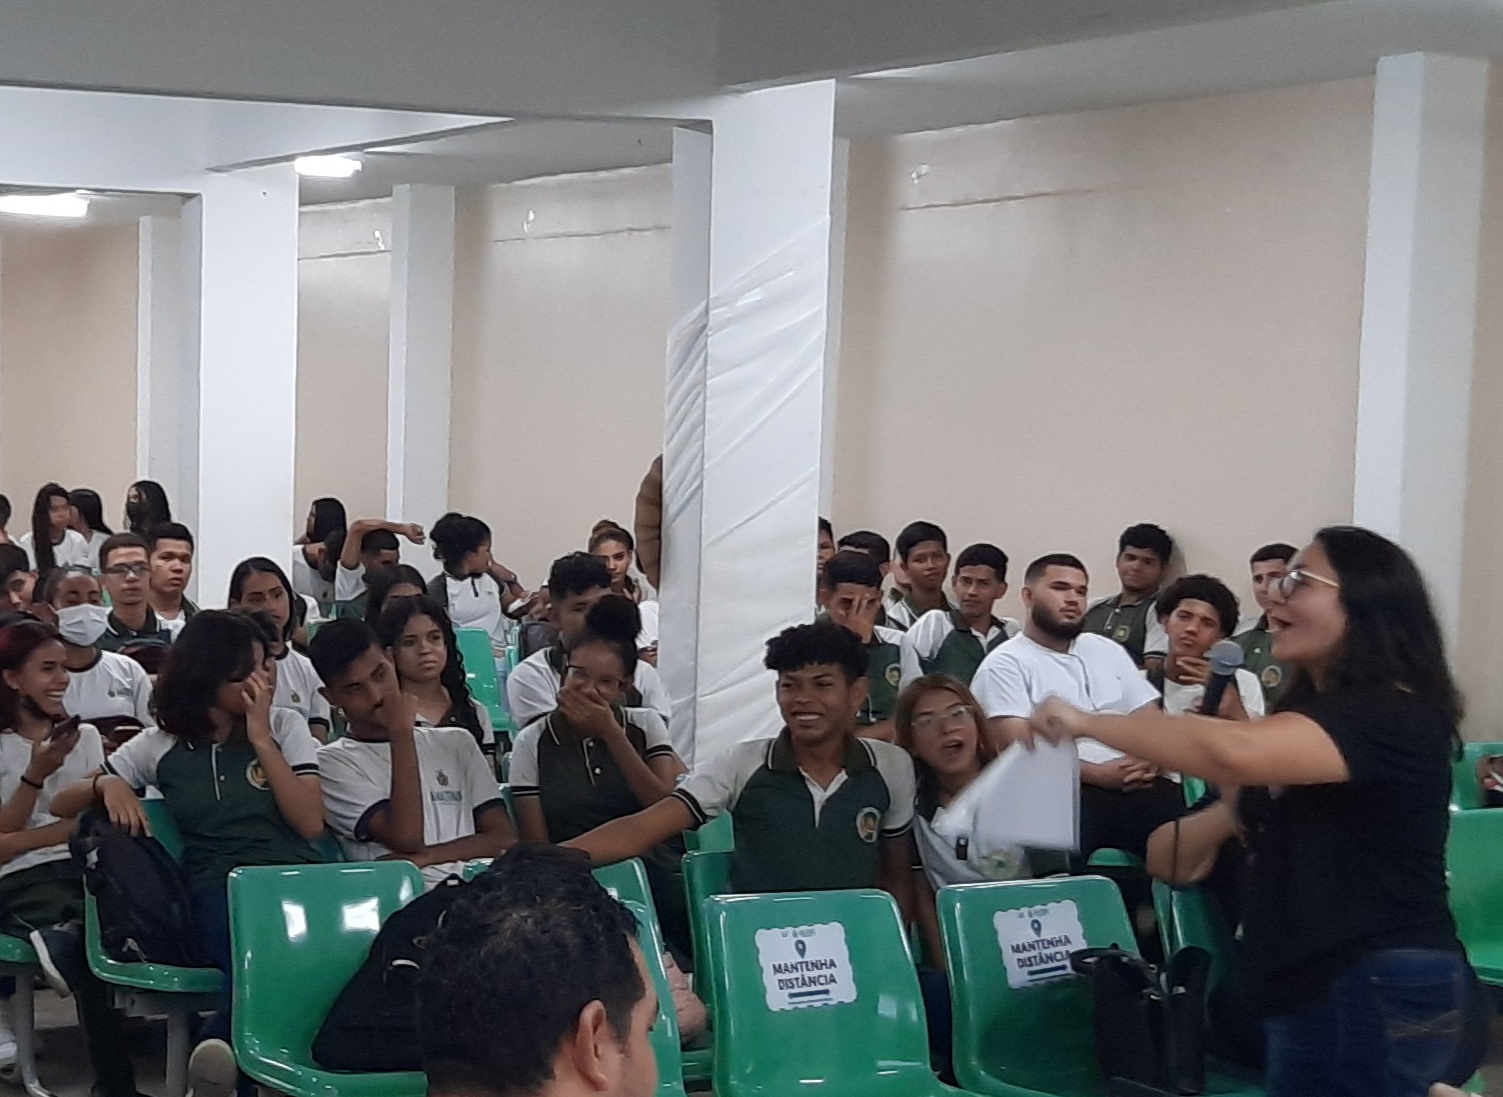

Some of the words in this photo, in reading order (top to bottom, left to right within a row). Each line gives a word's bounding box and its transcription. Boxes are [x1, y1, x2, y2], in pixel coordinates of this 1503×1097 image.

[1010, 935, 1072, 953] MANTENHA
[772, 959, 838, 976] MANTENHA
[1016, 950, 1072, 969] DISTÂNCIA
[777, 973, 838, 991] DISTÂNCIA
